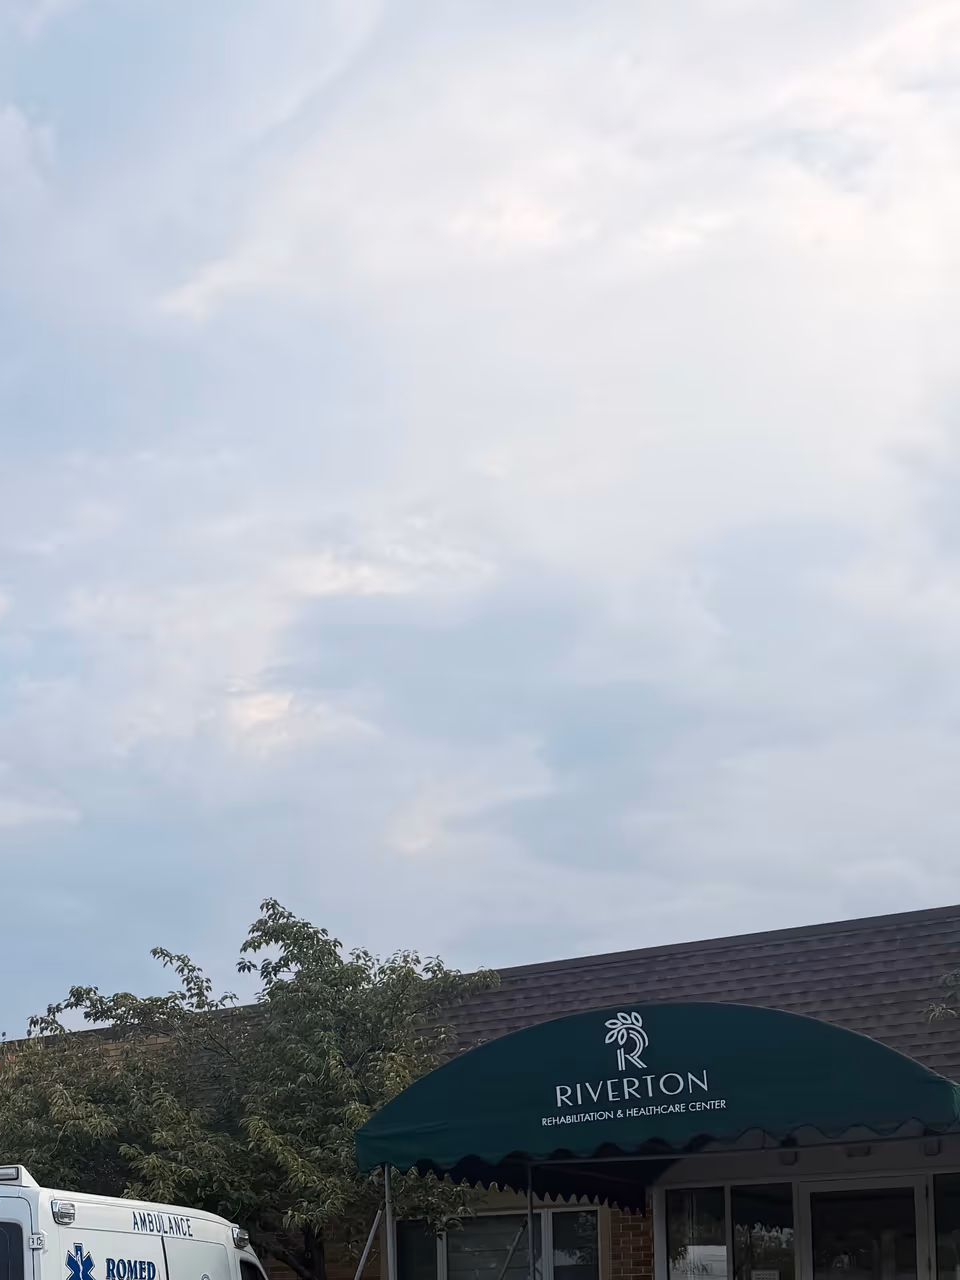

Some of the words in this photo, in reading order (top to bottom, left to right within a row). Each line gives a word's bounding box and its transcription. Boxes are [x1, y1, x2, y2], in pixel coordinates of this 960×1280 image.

[555, 1069, 709, 1107] RIVERTON
[541, 1110, 614, 1126] REHABILITATION
[616, 1109, 624, 1118] &
[626, 1103, 686, 1117] HEALTHCARE
[688, 1099, 727, 1112] CENTER
[132, 1211, 193, 1237] AMBULANCE
